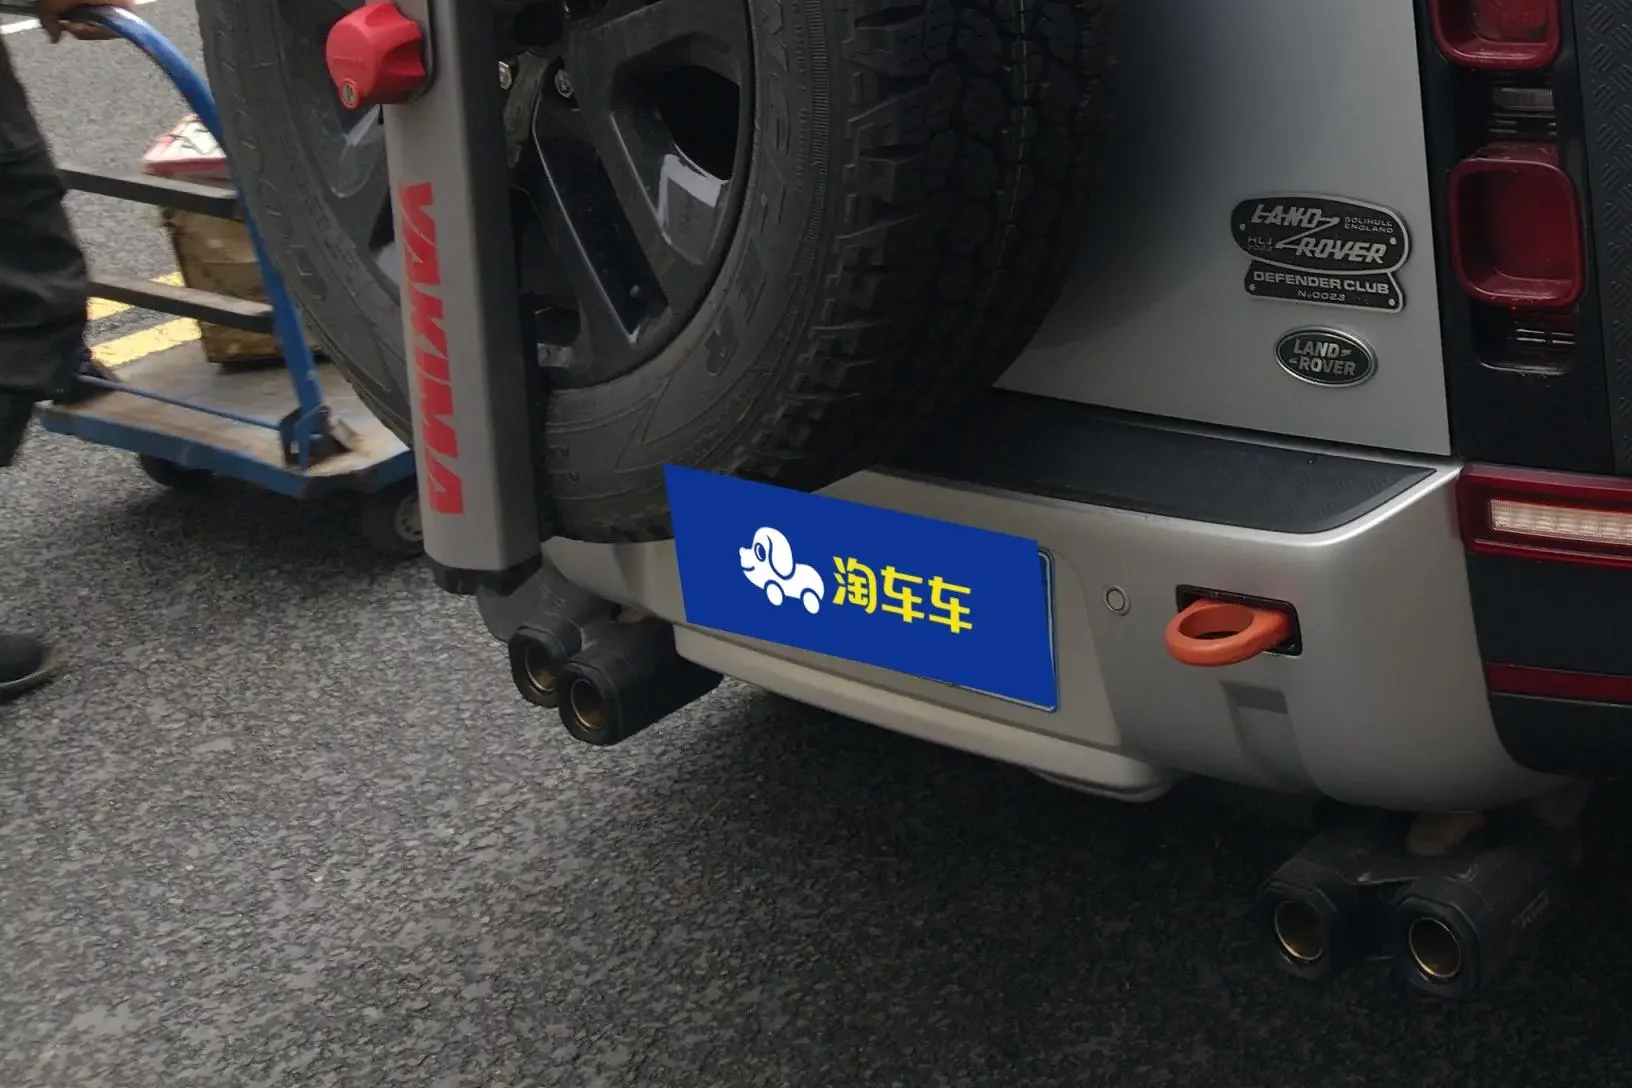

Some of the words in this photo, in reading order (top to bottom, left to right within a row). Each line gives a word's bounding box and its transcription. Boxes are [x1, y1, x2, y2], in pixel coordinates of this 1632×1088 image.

[1251, 204, 1323, 228] LAND
[1344, 223, 1393, 233] ENGLAND
[1296, 237, 1387, 263] ROVER
[1254, 271, 1341, 289] DEFENDER
[1343, 280, 1389, 295] CLUB
[398, 181, 464, 515] YAKIMA
[1293, 339, 1340, 357] LAND
[1300, 358, 1356, 376] ROVER
